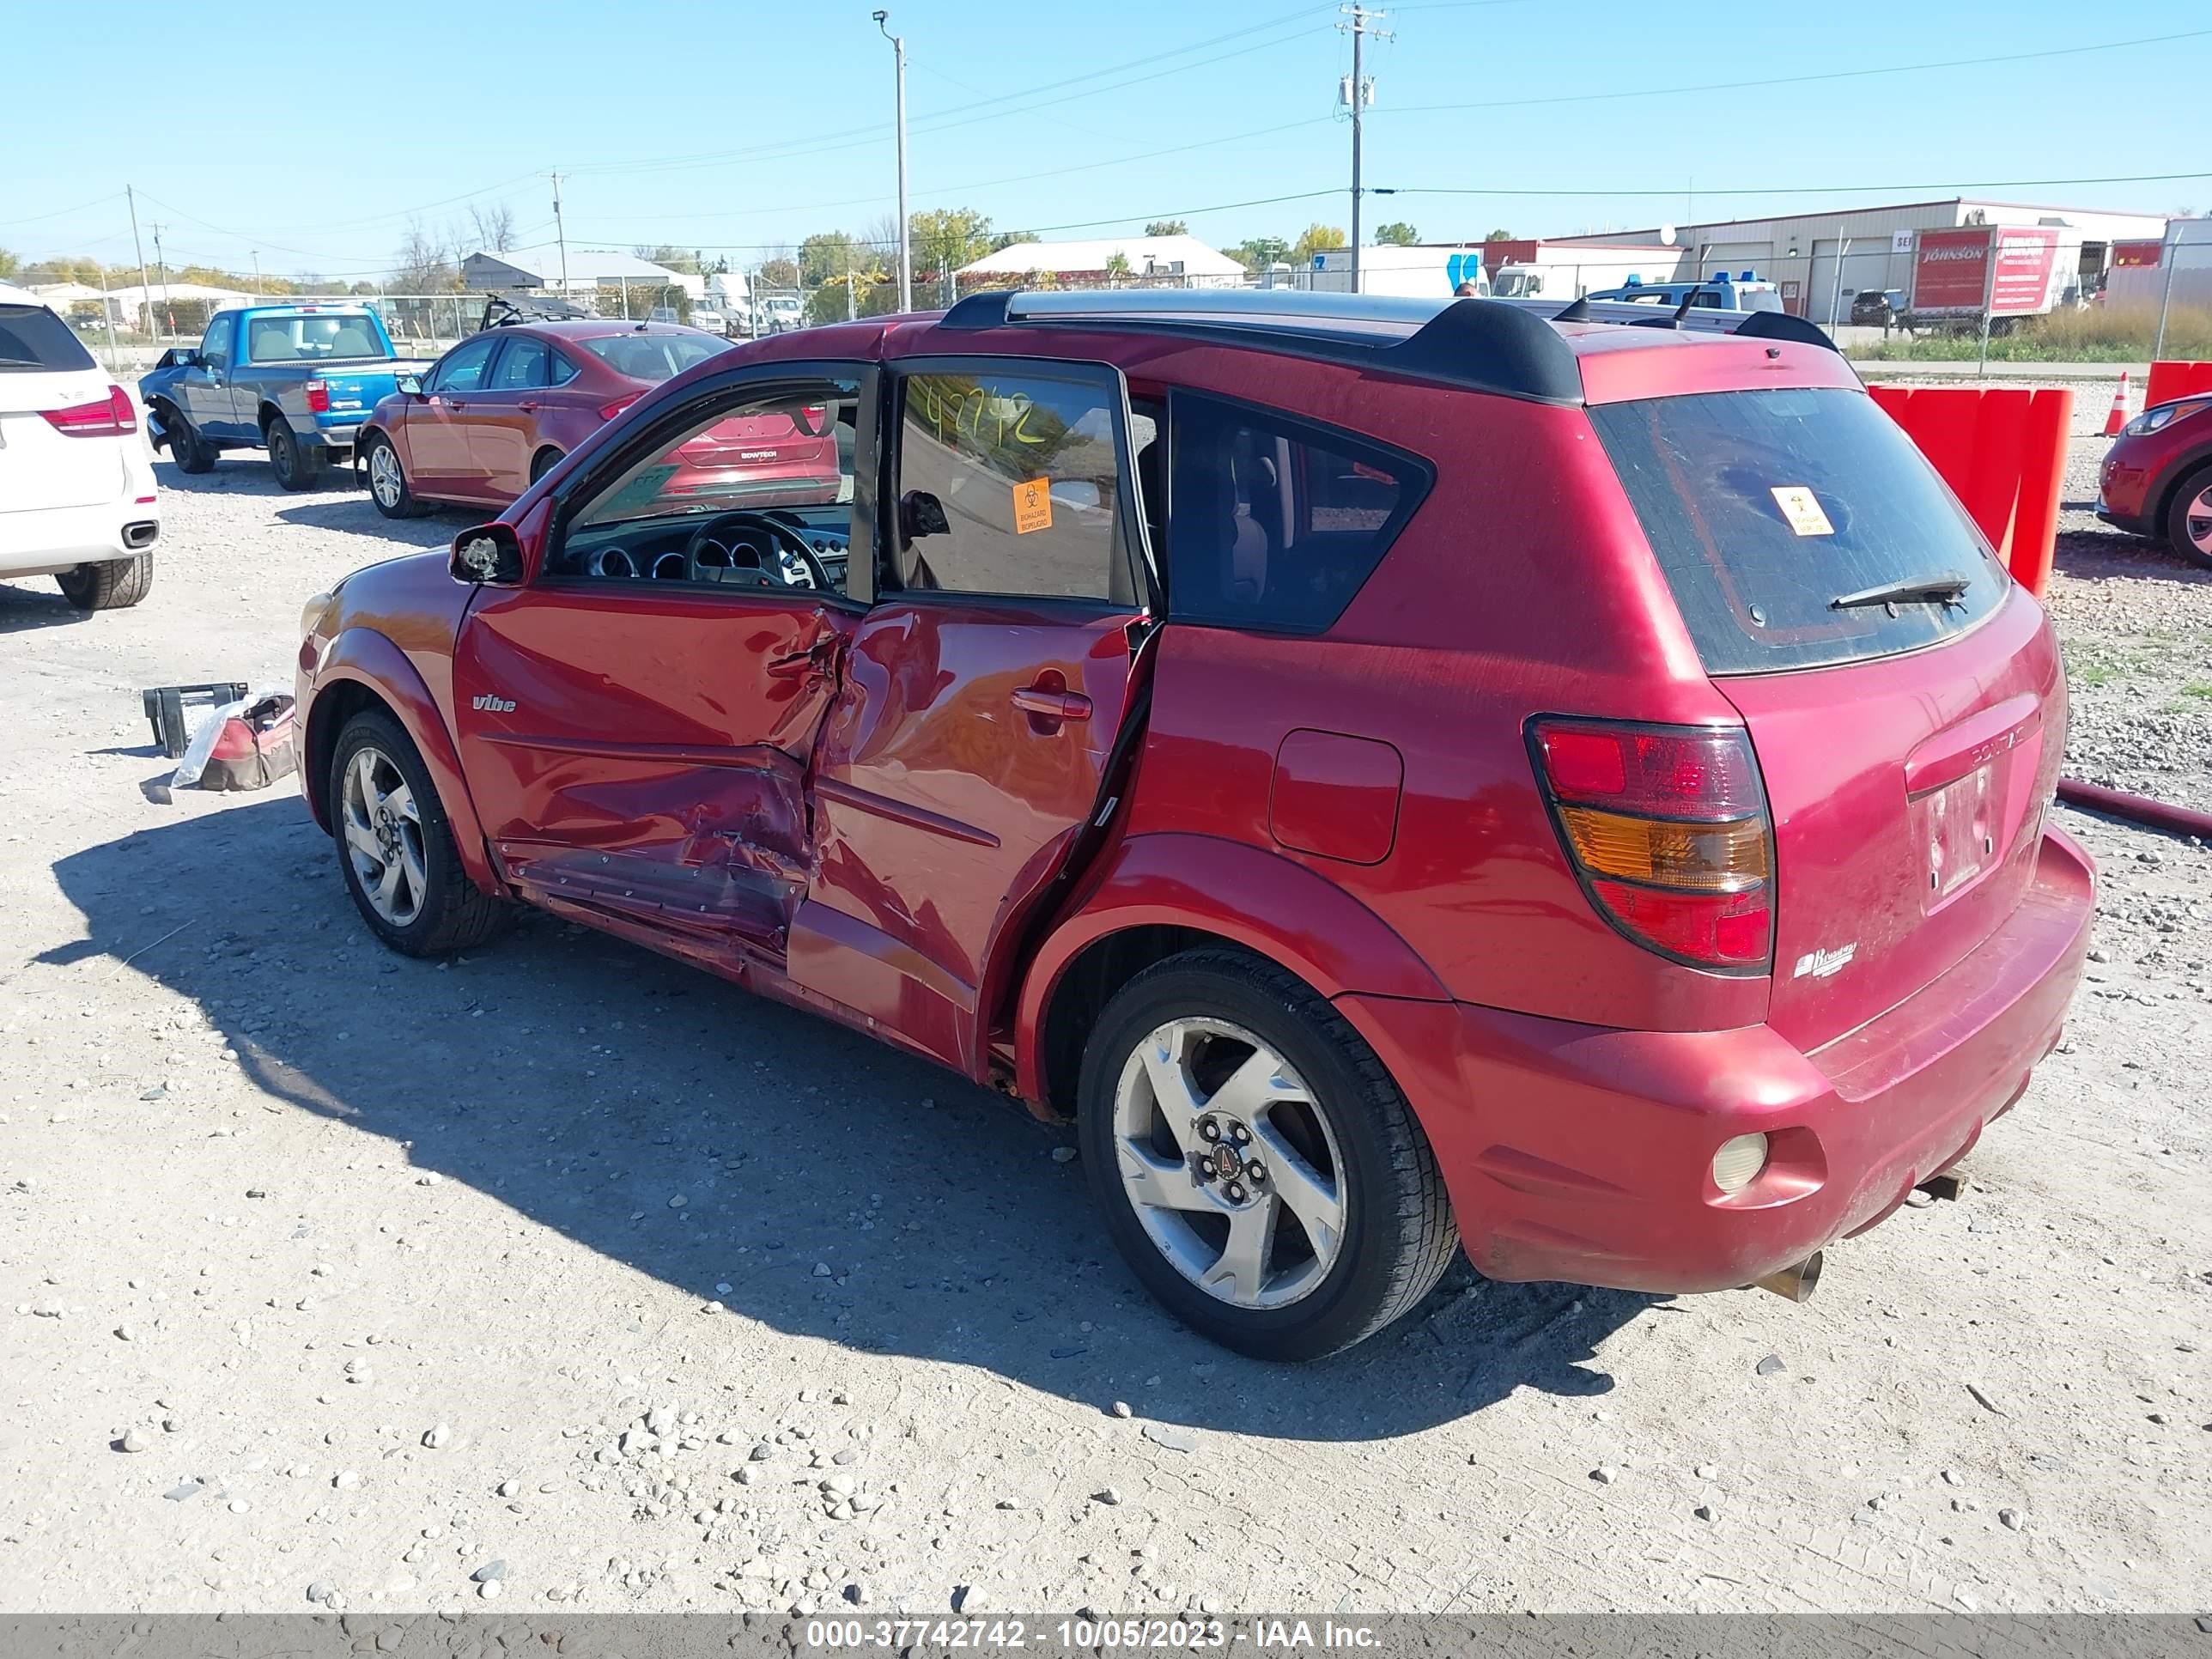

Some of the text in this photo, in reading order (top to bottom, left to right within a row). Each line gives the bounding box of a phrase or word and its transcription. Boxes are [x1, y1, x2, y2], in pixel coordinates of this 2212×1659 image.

[1923, 248, 1983, 264] JOHNSON
[927, 385, 1046, 447] 42742
[1020, 509, 1047, 521] BIOHAZARD
[473, 694, 516, 713] vibe
